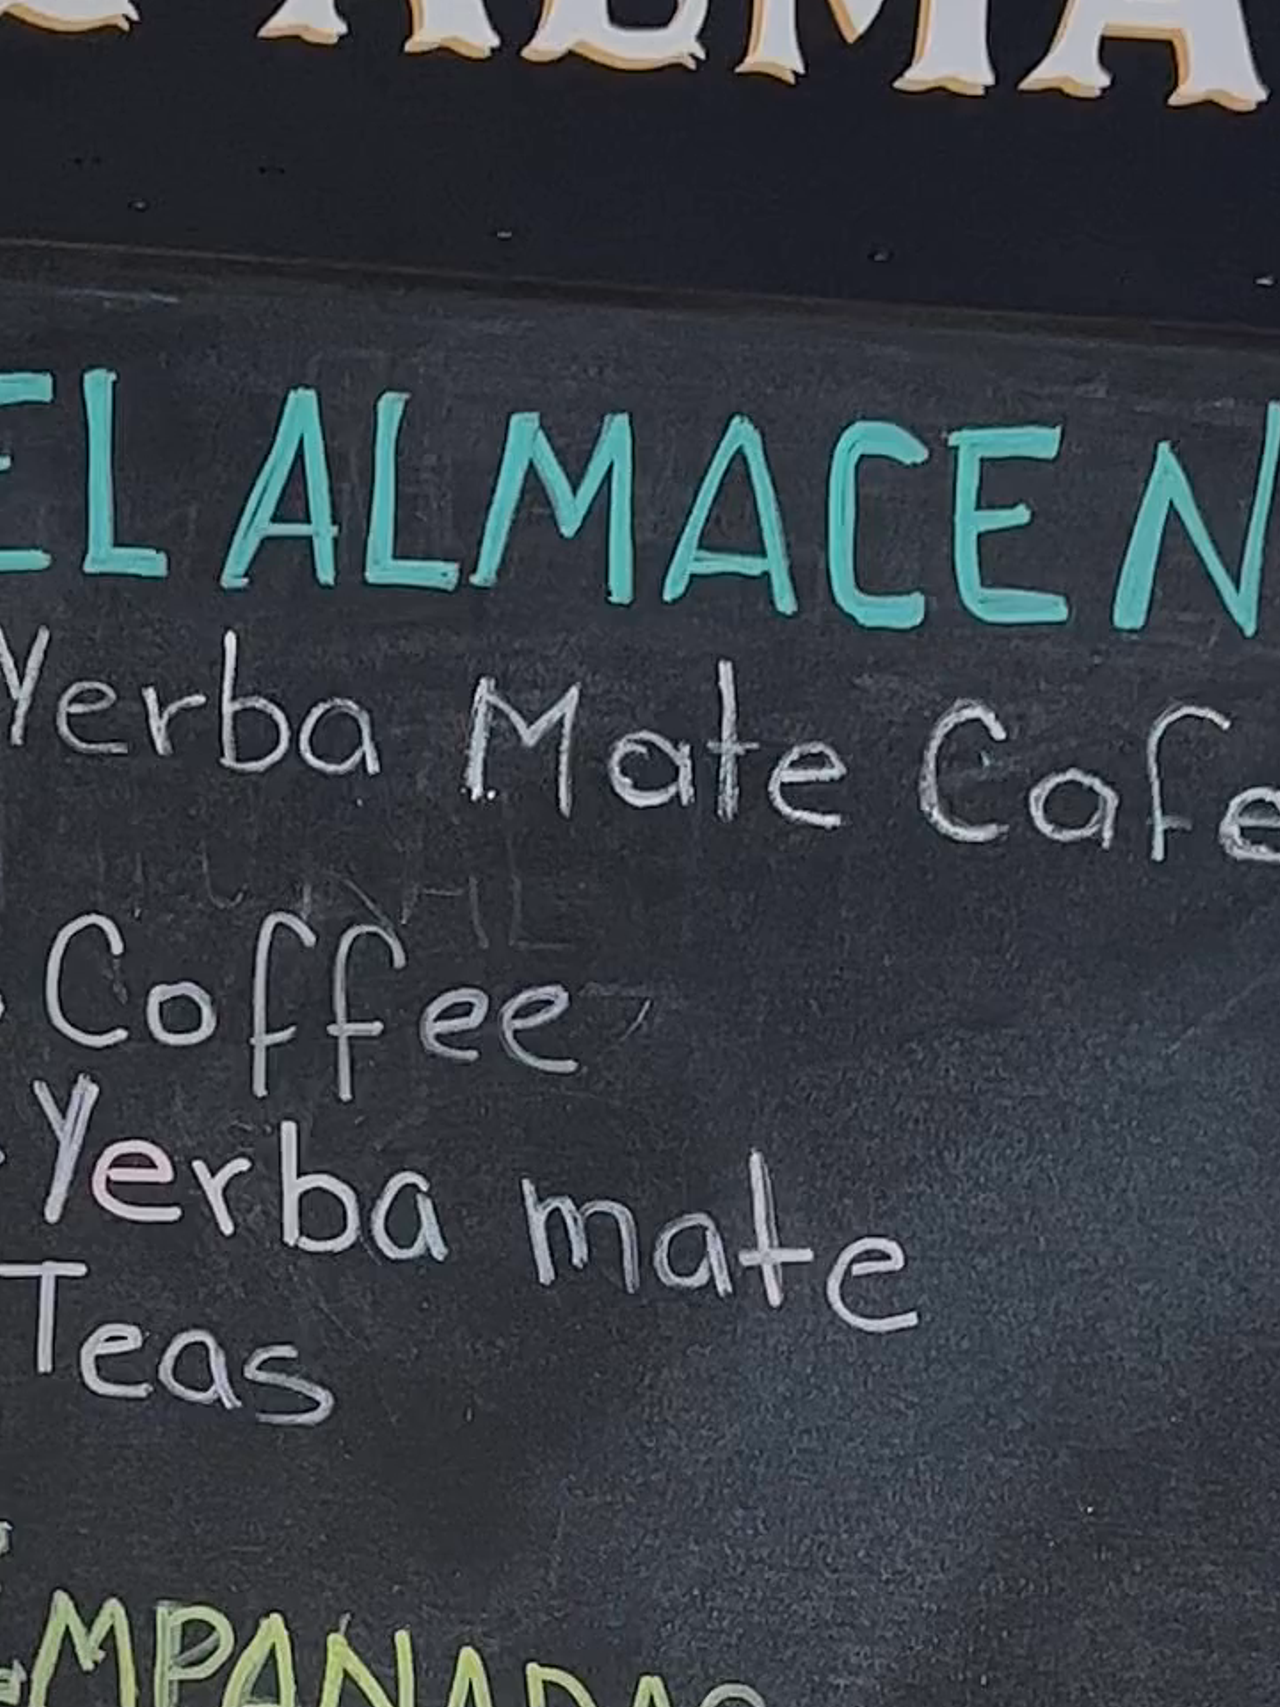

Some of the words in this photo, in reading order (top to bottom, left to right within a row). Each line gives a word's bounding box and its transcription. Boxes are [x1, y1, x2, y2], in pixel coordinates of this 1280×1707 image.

[462, 659, 847, 828] Mate
[45, 912, 580, 1101] Coffee
[33, 1073, 447, 1268] Yerba
[520, 1147, 919, 1333] mate
